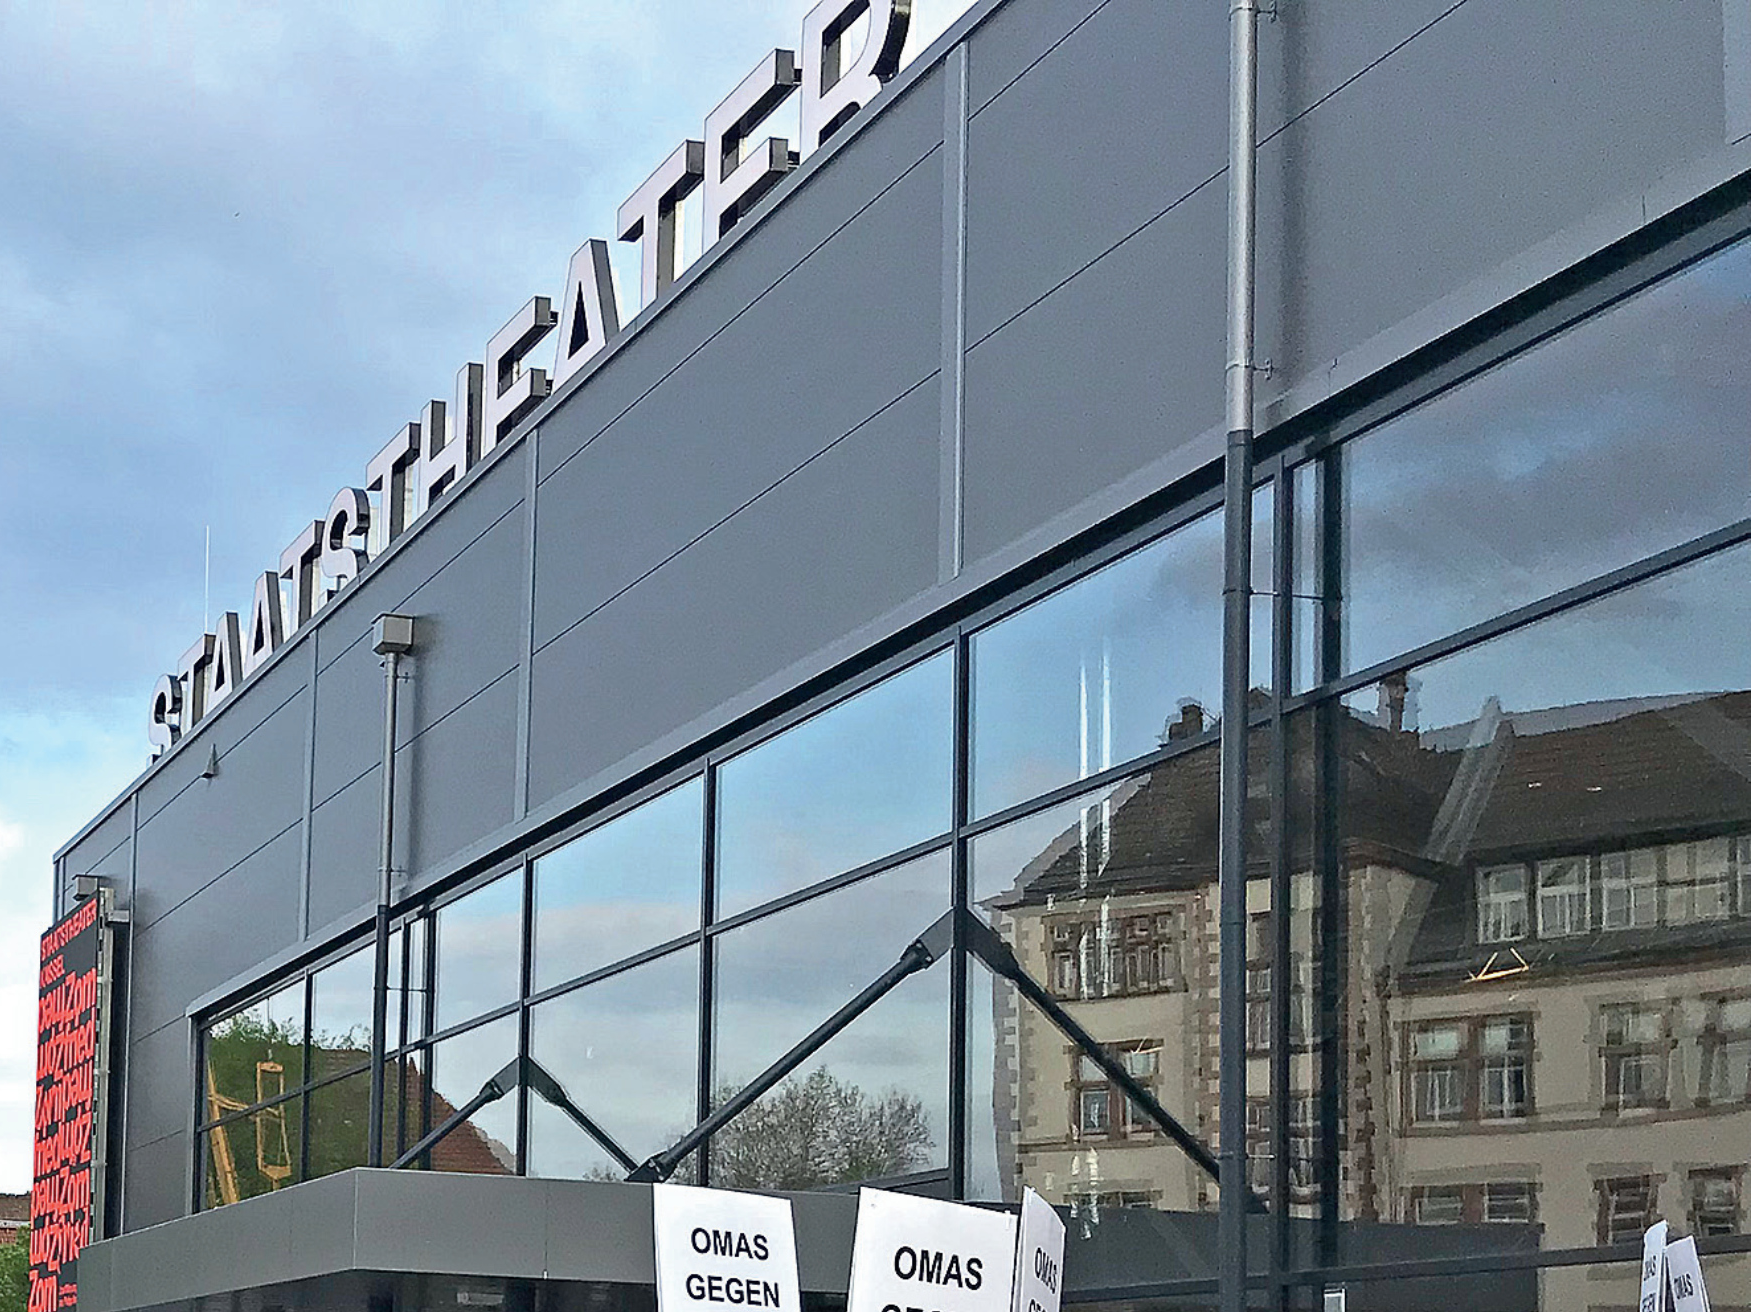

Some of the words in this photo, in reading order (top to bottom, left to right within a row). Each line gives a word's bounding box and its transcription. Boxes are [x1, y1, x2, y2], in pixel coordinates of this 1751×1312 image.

[149, 0, 912, 756] STAATSTHEATER
[691, 1227, 769, 1260] OMAS
[894, 1246, 983, 1290] OMAS
[1034, 1247, 1057, 1294] OMAS
[686, 1274, 780, 1308] GEGEN
